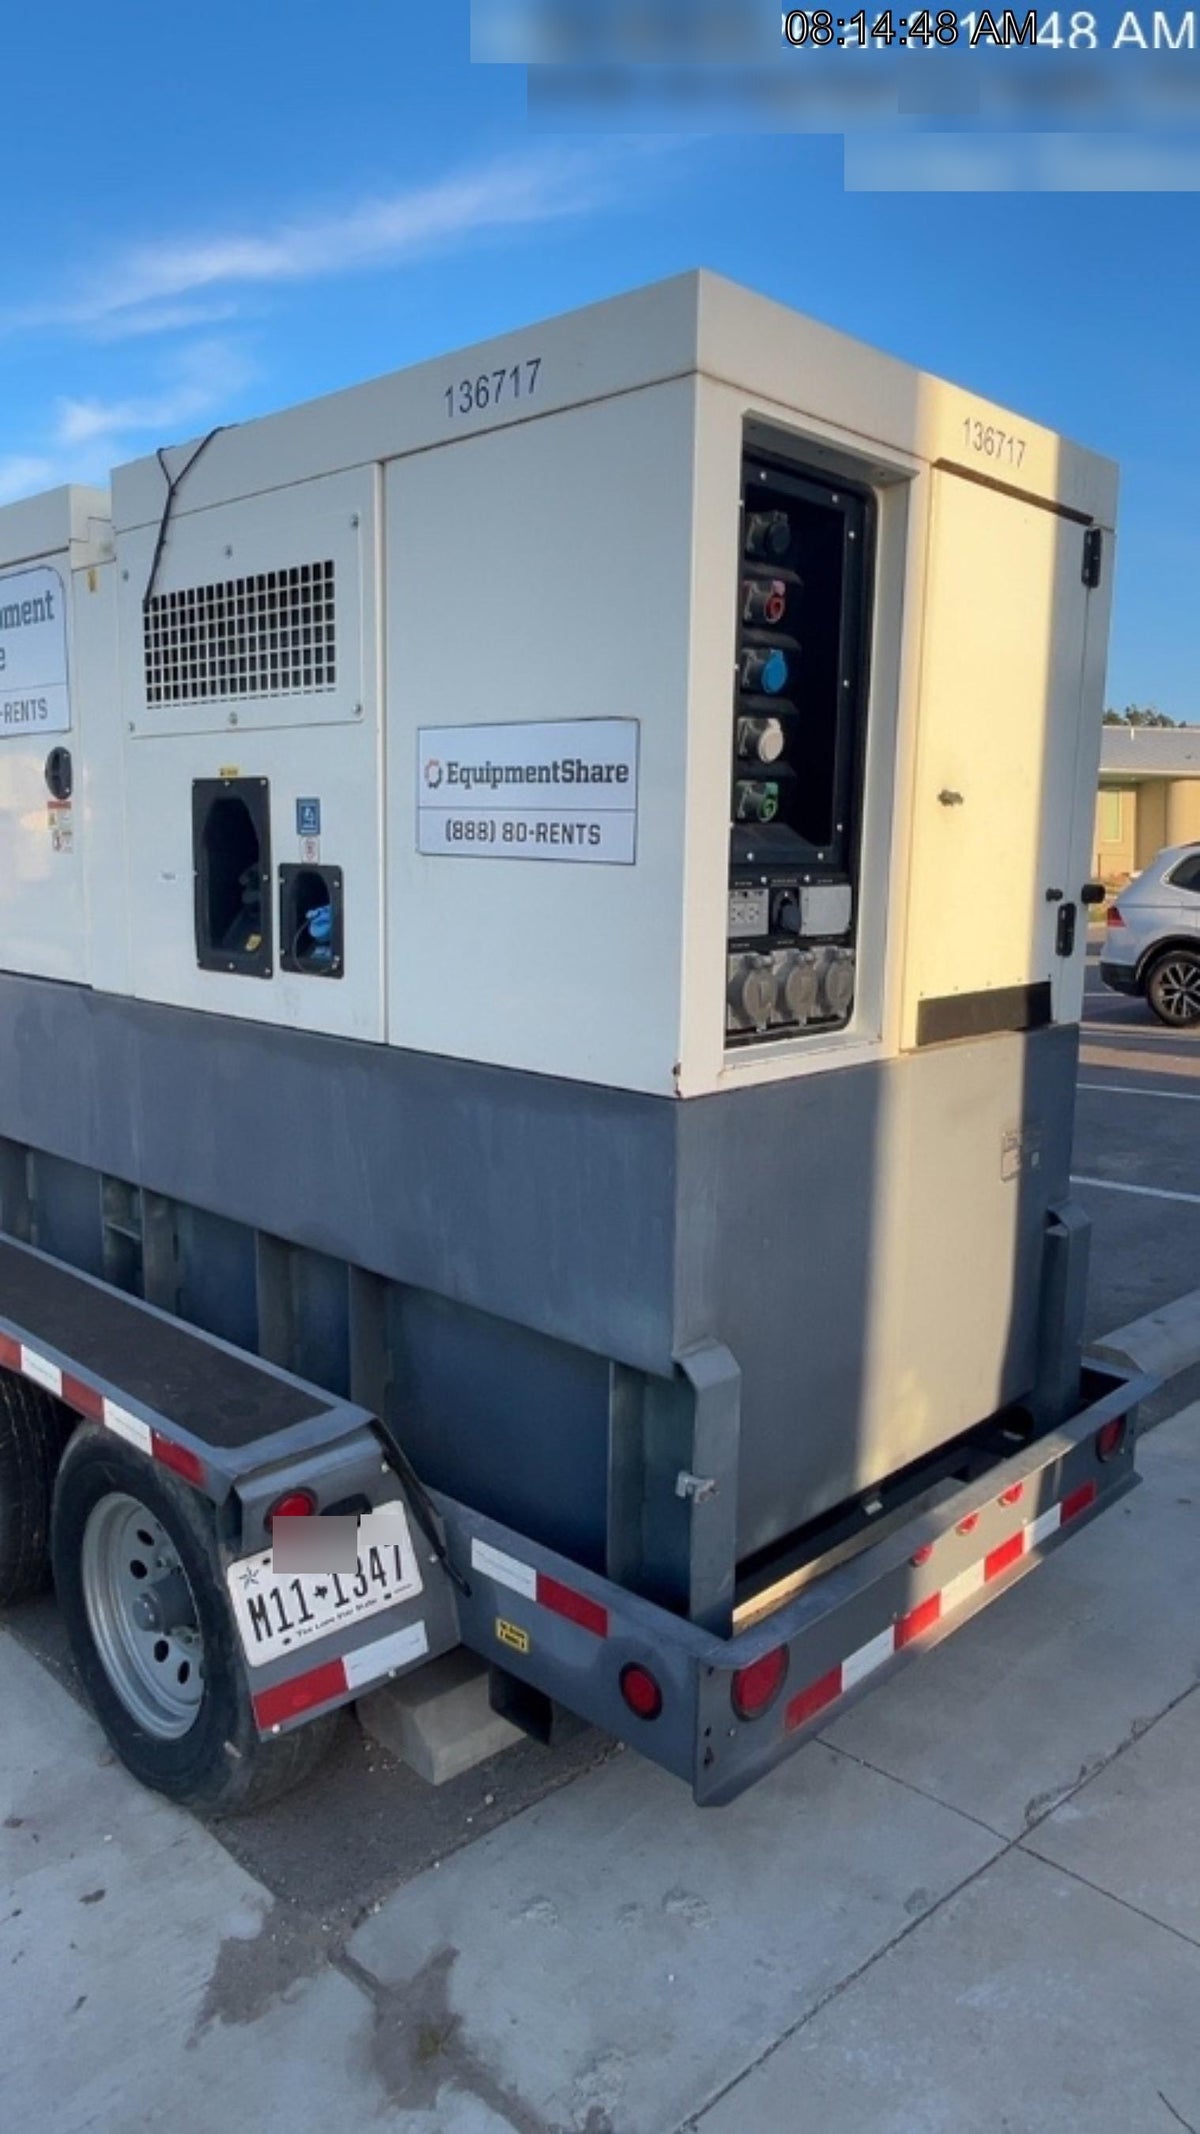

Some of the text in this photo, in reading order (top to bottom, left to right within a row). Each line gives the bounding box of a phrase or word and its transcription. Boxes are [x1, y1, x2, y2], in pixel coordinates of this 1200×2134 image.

[444, 358, 542, 418] 136717
[963, 417, 1026, 469] 136717
[0, 589, 55, 630] ment
[446, 758, 630, 790] EquipmentShare
[445, 819, 602, 845] (888) 80-RENTS
